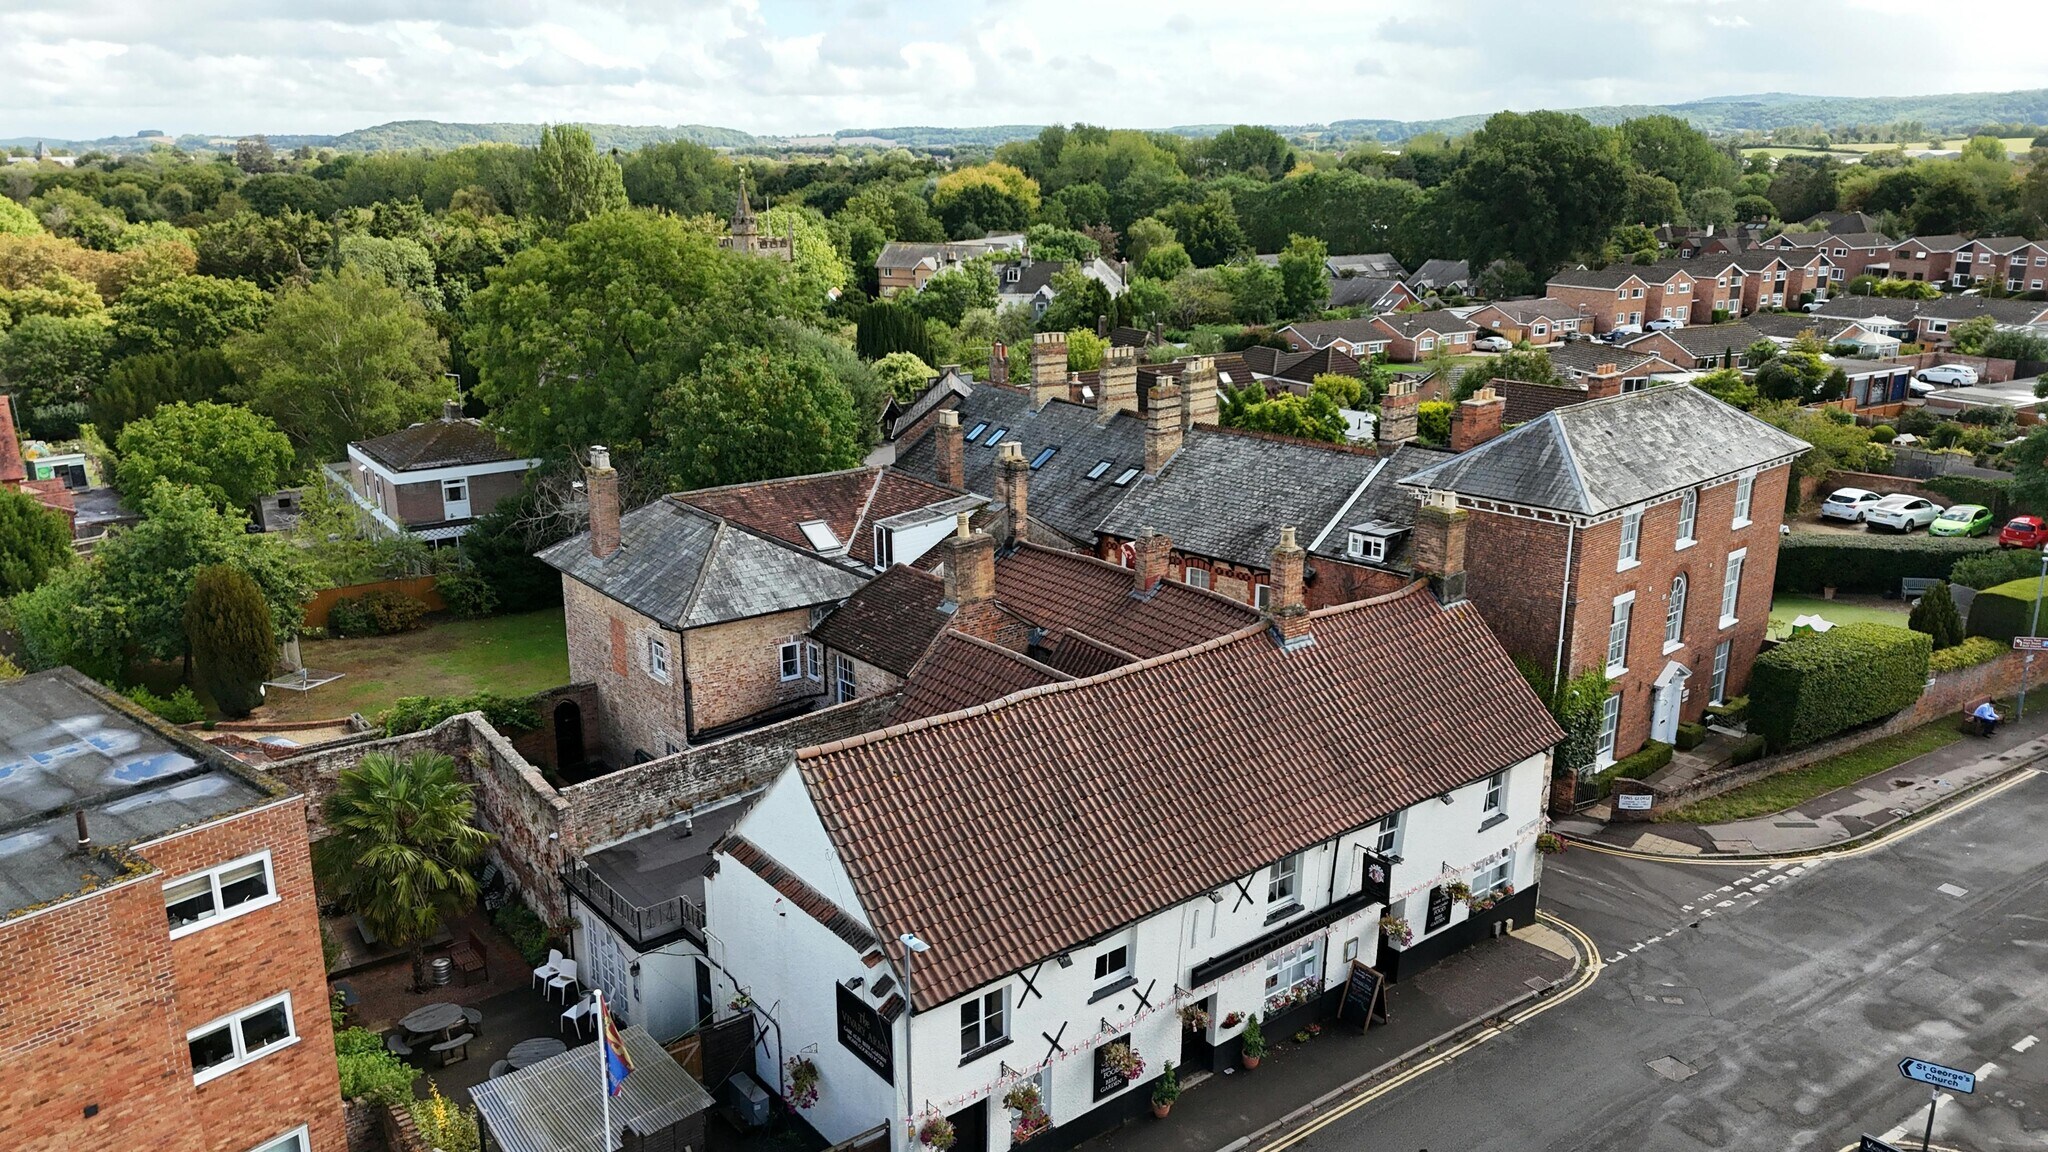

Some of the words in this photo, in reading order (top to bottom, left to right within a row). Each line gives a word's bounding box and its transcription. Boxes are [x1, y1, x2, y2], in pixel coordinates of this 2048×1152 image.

[1916, 1063, 1927, 1071] St
[1930, 1066, 1971, 1082] George's
[1100, 1078, 1122, 1093] GARDEN
[1105, 1075, 1118, 1085] BEER
[1925, 1073, 1959, 1087] Church
